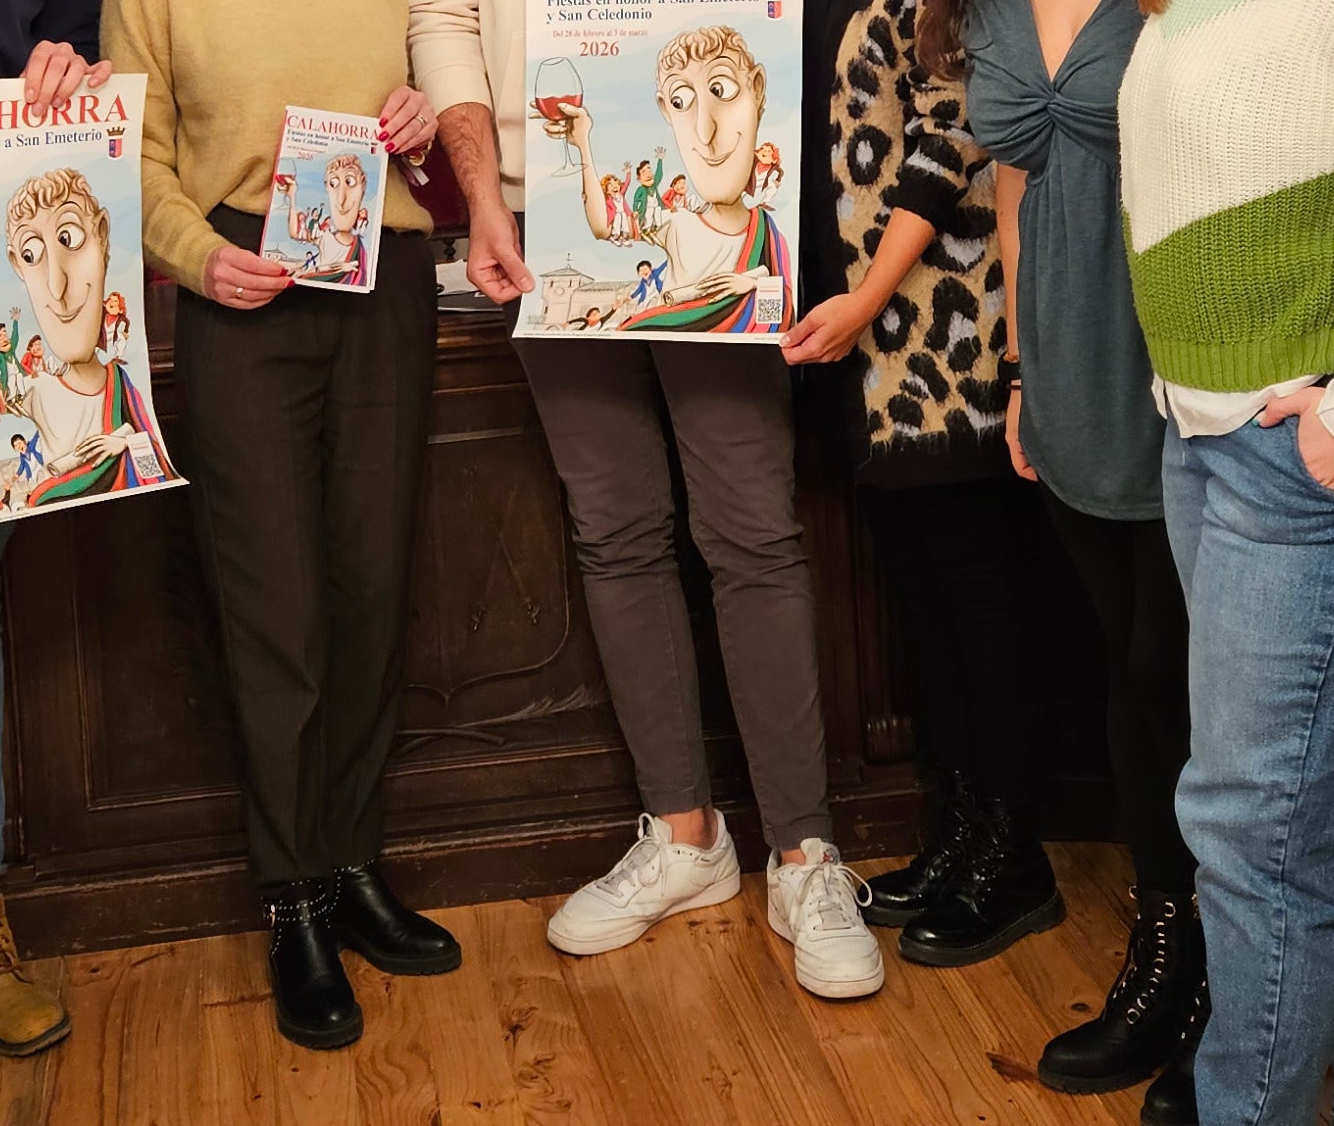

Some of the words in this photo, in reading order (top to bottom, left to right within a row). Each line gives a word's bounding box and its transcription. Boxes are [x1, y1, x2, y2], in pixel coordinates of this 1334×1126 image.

[547, 13, 554, 24] y
[559, 10, 582, 21] San
[588, 8, 652, 20] Celedonio
[580, 41, 619, 56] 2026
[288, 115, 380, 140] CALAHORRA
[4, 138, 11, 148] a
[16, 134, 39, 147] San
[45, 128, 102, 144] Emeterio
